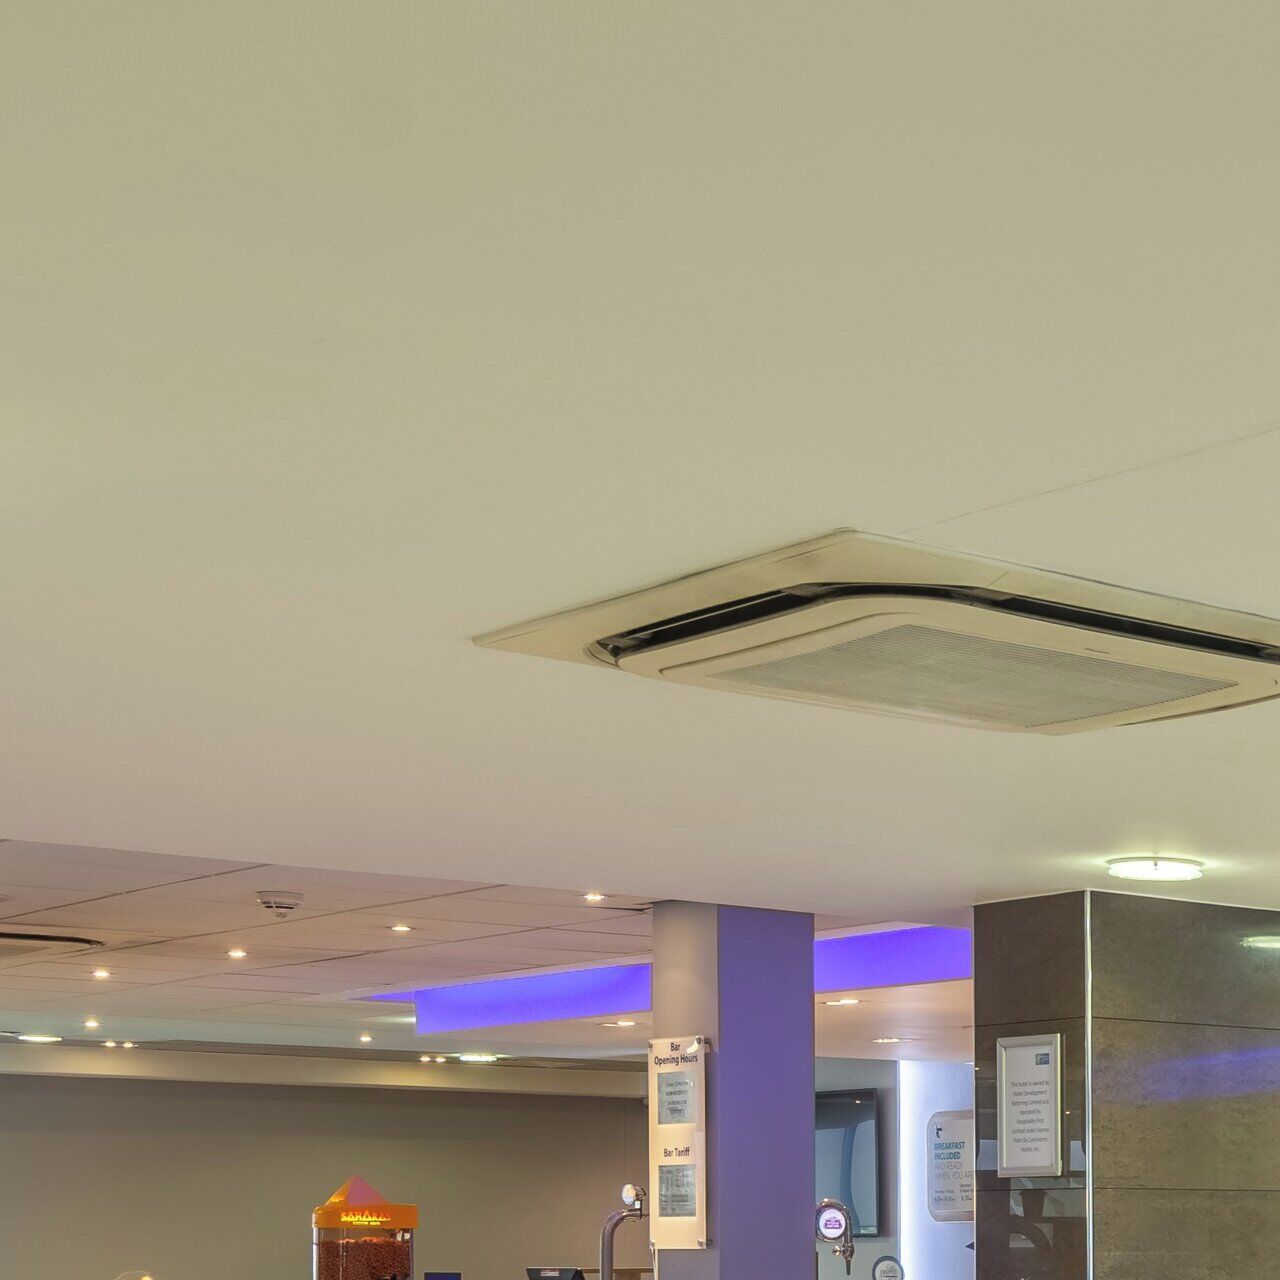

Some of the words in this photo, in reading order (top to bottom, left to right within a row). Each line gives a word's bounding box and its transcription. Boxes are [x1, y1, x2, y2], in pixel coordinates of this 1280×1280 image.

[670, 1042, 681, 1052] Bar
[654, 1054, 680, 1067] Opening
[680, 1054, 698, 1063] Hours
[663, 1147, 674, 1158] Bar
[674, 1146, 690, 1157] Tariff
